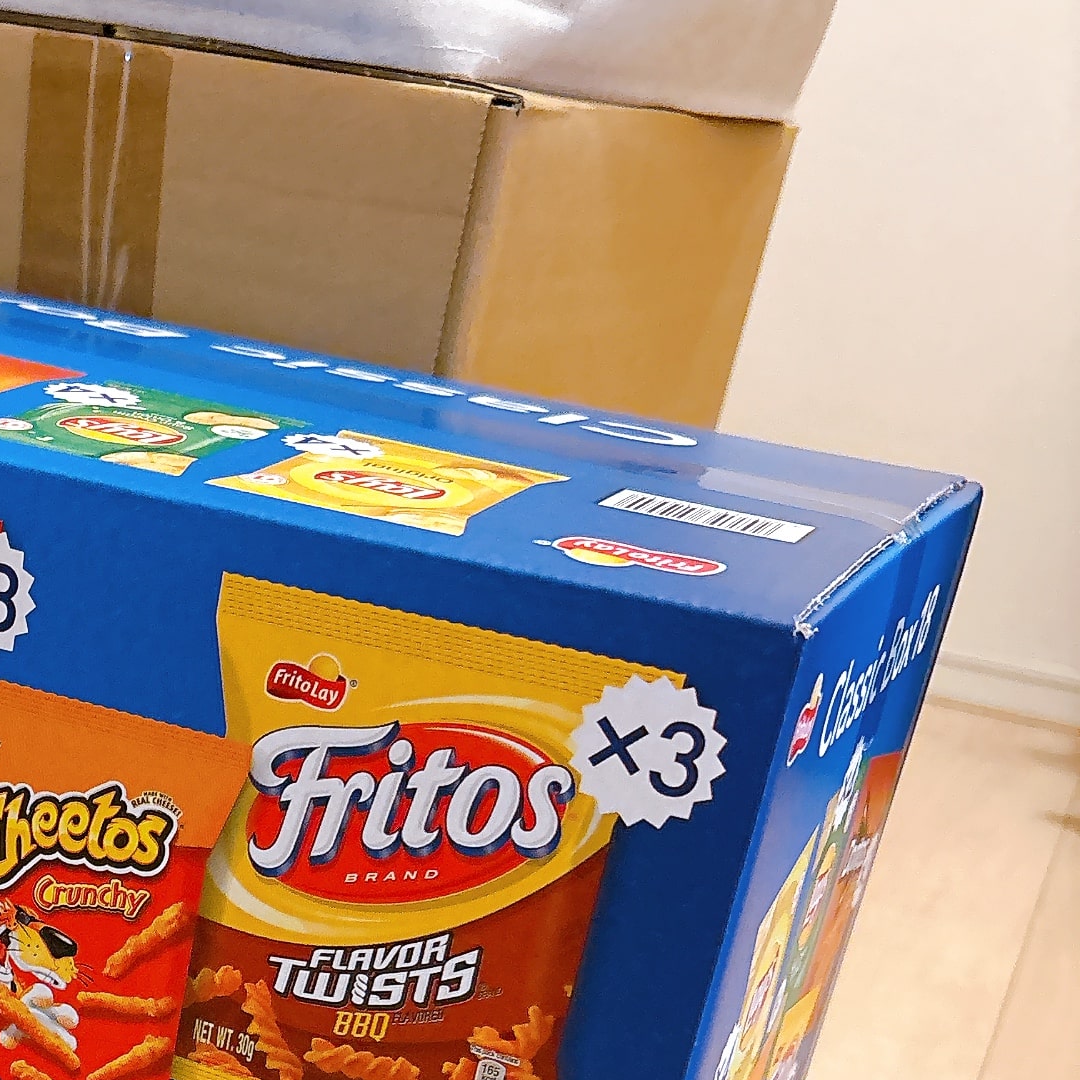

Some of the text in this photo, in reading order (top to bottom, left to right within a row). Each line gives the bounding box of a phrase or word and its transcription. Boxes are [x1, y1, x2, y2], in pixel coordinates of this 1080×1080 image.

[819, 634, 887, 757] Classic
[131, 795, 150, 808] REAL
[249, 722, 573, 874] Fritos
[344, 868, 440, 884] BRAND
[36, 877, 149, 918] Crunchy
[309, 933, 451, 971] FLAVOR
[268, 946, 482, 1006] TWISTS
[192, 1019, 255, 1062] NET WT. 30g
[332, 1010, 389, 1042] BBQ
[482, 1063, 500, 1077] 165
